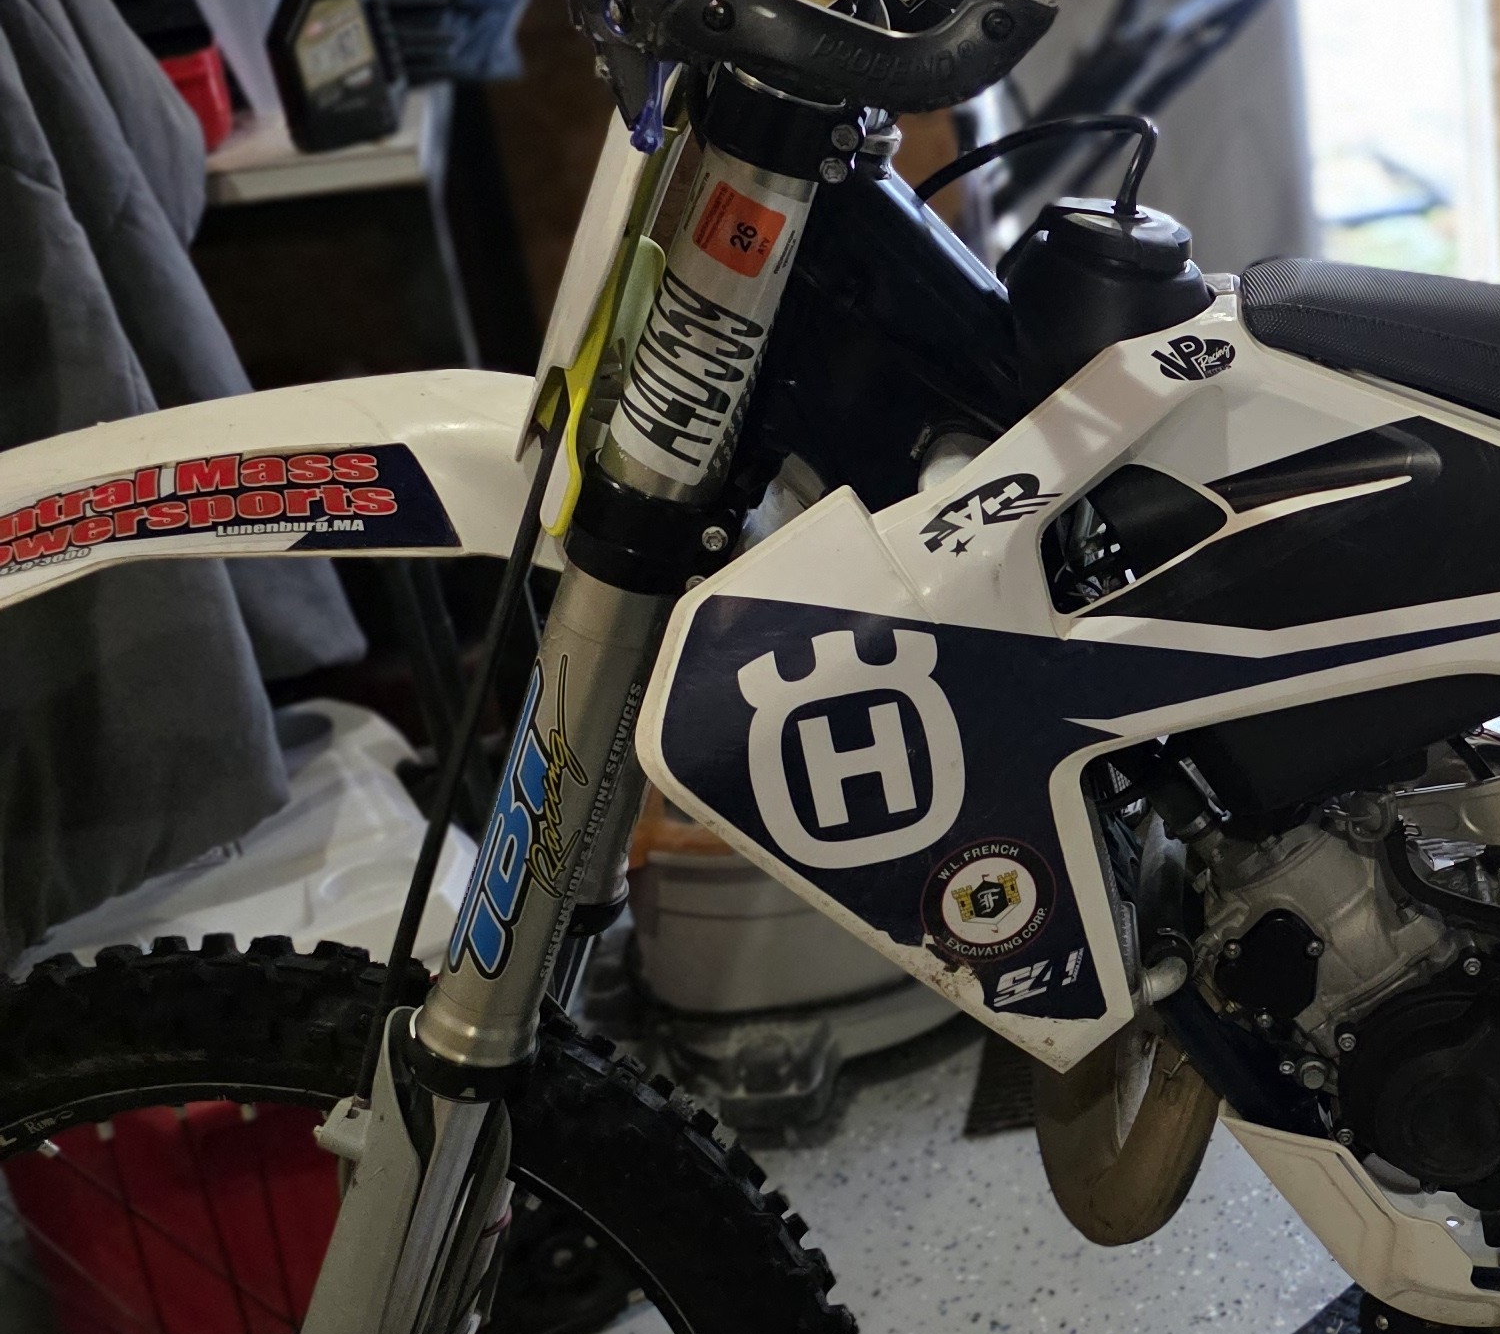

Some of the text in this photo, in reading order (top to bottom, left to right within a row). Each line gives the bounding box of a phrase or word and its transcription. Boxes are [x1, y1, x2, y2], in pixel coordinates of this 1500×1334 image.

[730, 222, 757, 253] 26
[757, 237, 770, 255] ATV
[1151, 335, 1231, 380] VP Racing
[176, 453, 379, 495] Mass
[525, 654, 589, 898] Racing
[797, 701, 917, 829] H
[540, 865, 583, 979] SUSPENSION
[583, 777, 612, 845] ENGINE
[605, 681, 642, 778] SERVICES
[938, 844, 1020, 881] W.L. FRENCH
[946, 907, 1048, 957] EXCAVATING CORP.
